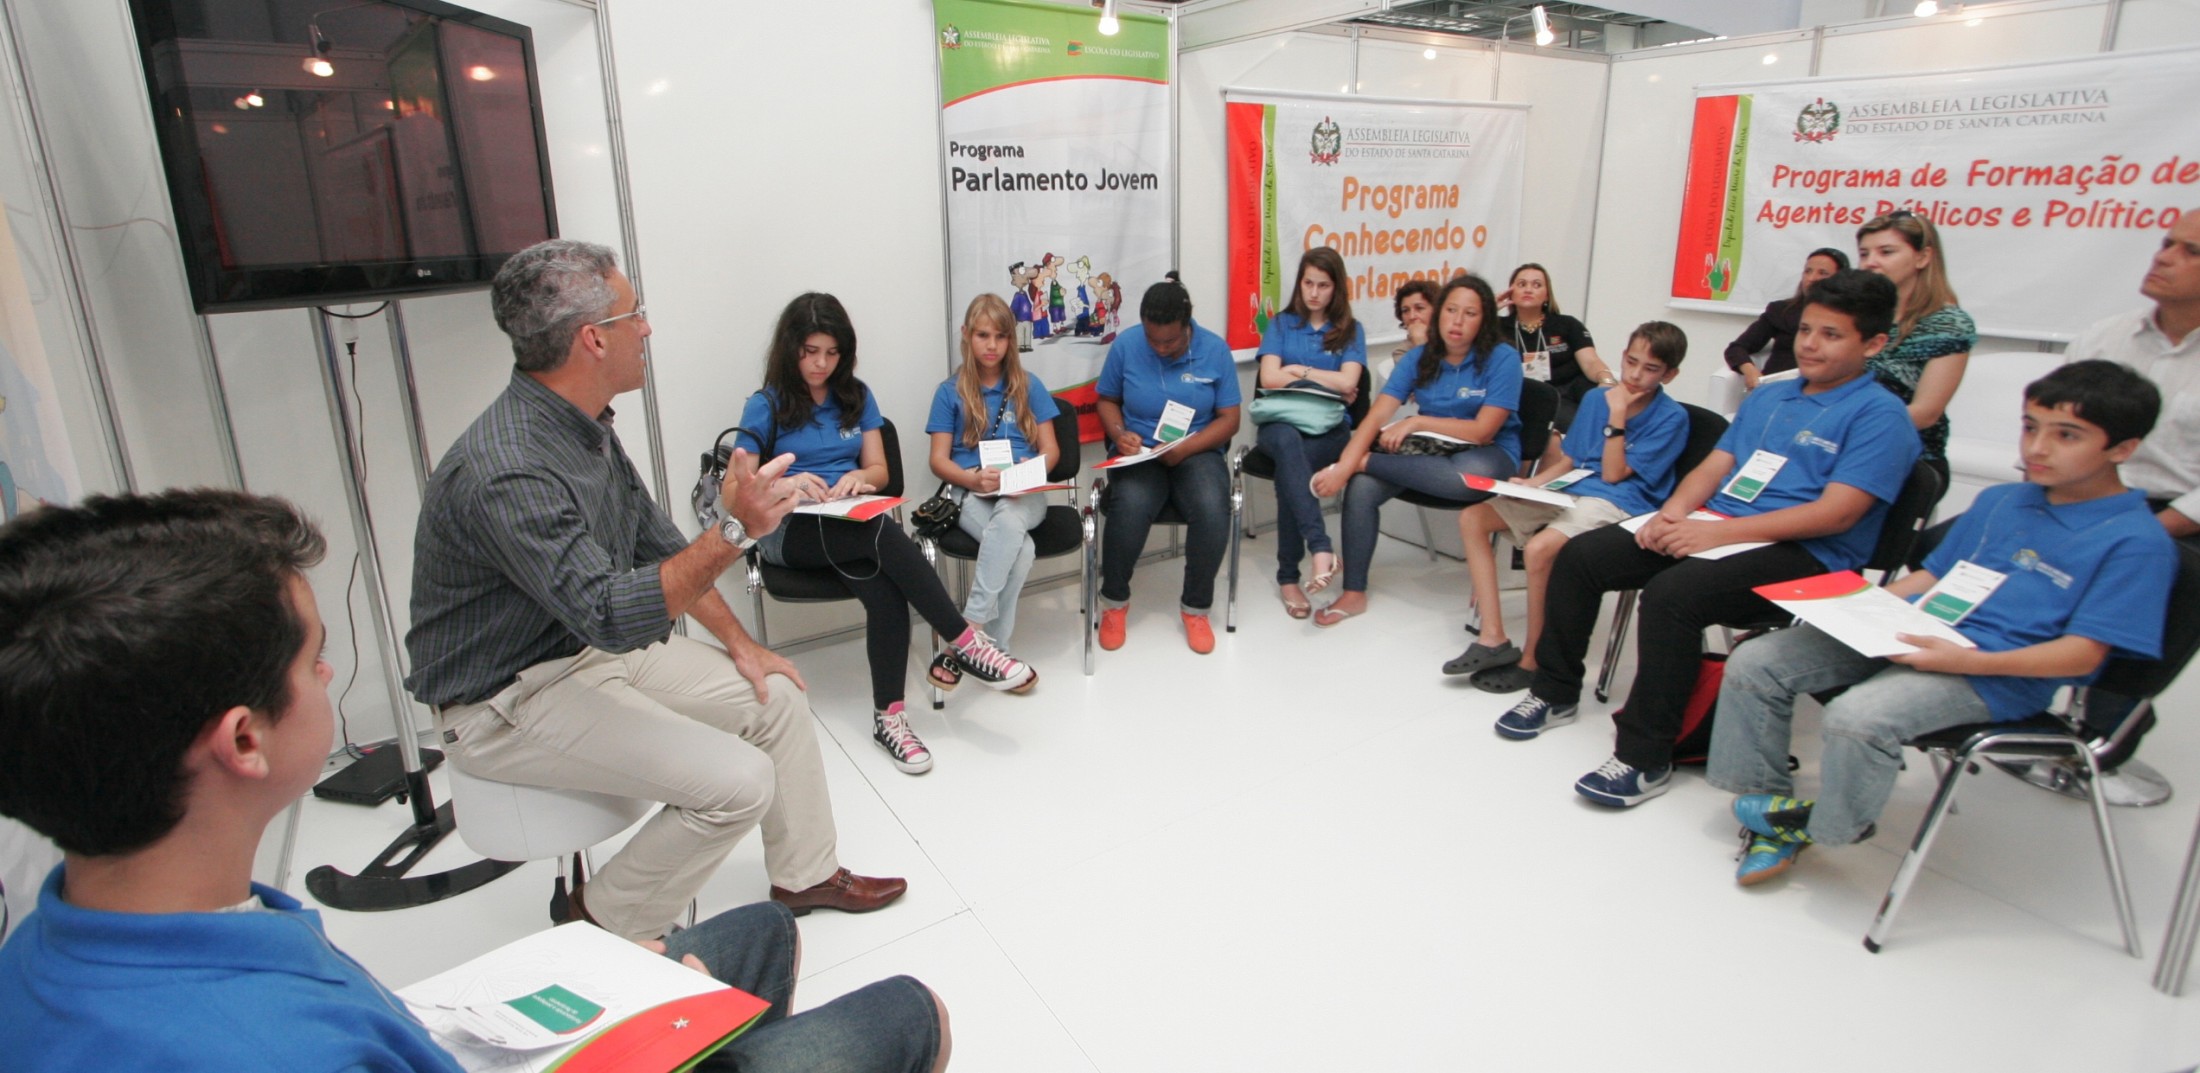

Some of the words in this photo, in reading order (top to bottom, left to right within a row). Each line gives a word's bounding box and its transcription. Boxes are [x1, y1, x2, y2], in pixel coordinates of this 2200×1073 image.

[964, 30, 1005, 42] ASSEMBLEIA
[1008, 34, 1050, 46] LEGISLATIVA
[1084, 46, 1109, 56] ESCOLA
[1110, 48, 1121, 57] DO
[1121, 48, 1160, 60] LEGISLATIVO
[1848, 98, 1962, 119] ASSEMBLEIA
[1970, 89, 2109, 112] LEGISLATIVA
[1347, 127, 1409, 142] ASSEMBLEIA
[1413, 129, 1471, 144] LEGISLATIVA
[1845, 123, 1868, 135] DO
[1872, 120, 1929, 134] ESTADO
[1934, 118, 1954, 131] DE
[1959, 116, 2011, 130] SANTA
[2016, 111, 2107, 127] CATARINA
[950, 141, 1025, 161] Programa
[1345, 147, 1360, 158] DO
[1361, 147, 1393, 158] ESTADO
[1395, 148, 1406, 158] DE
[1408, 148, 1431, 159] SANTA
[1432, 149, 1470, 159] CATARINA
[952, 167, 1088, 192] Parlamento
[1095, 168, 1158, 191] Jovem
[1772, 164, 1901, 194] Programa
[1910, 162, 1948, 188] de
[1967, 154, 2141, 195] Formação
[2152, 155, 2200, 185] de
[1342, 176, 1460, 219] Programa
[1756, 200, 1866, 229] Agentes
[2012, 207, 2031, 227] e
[2043, 198, 2181, 229] Político
[1246, 220, 1256, 239] DO
[1303, 219, 1465, 257] Conhecendo
[1472, 225, 1487, 248] o
[1704, 212, 1717, 247] ESCOLA
[1246, 242, 1256, 285] ESCOLA
